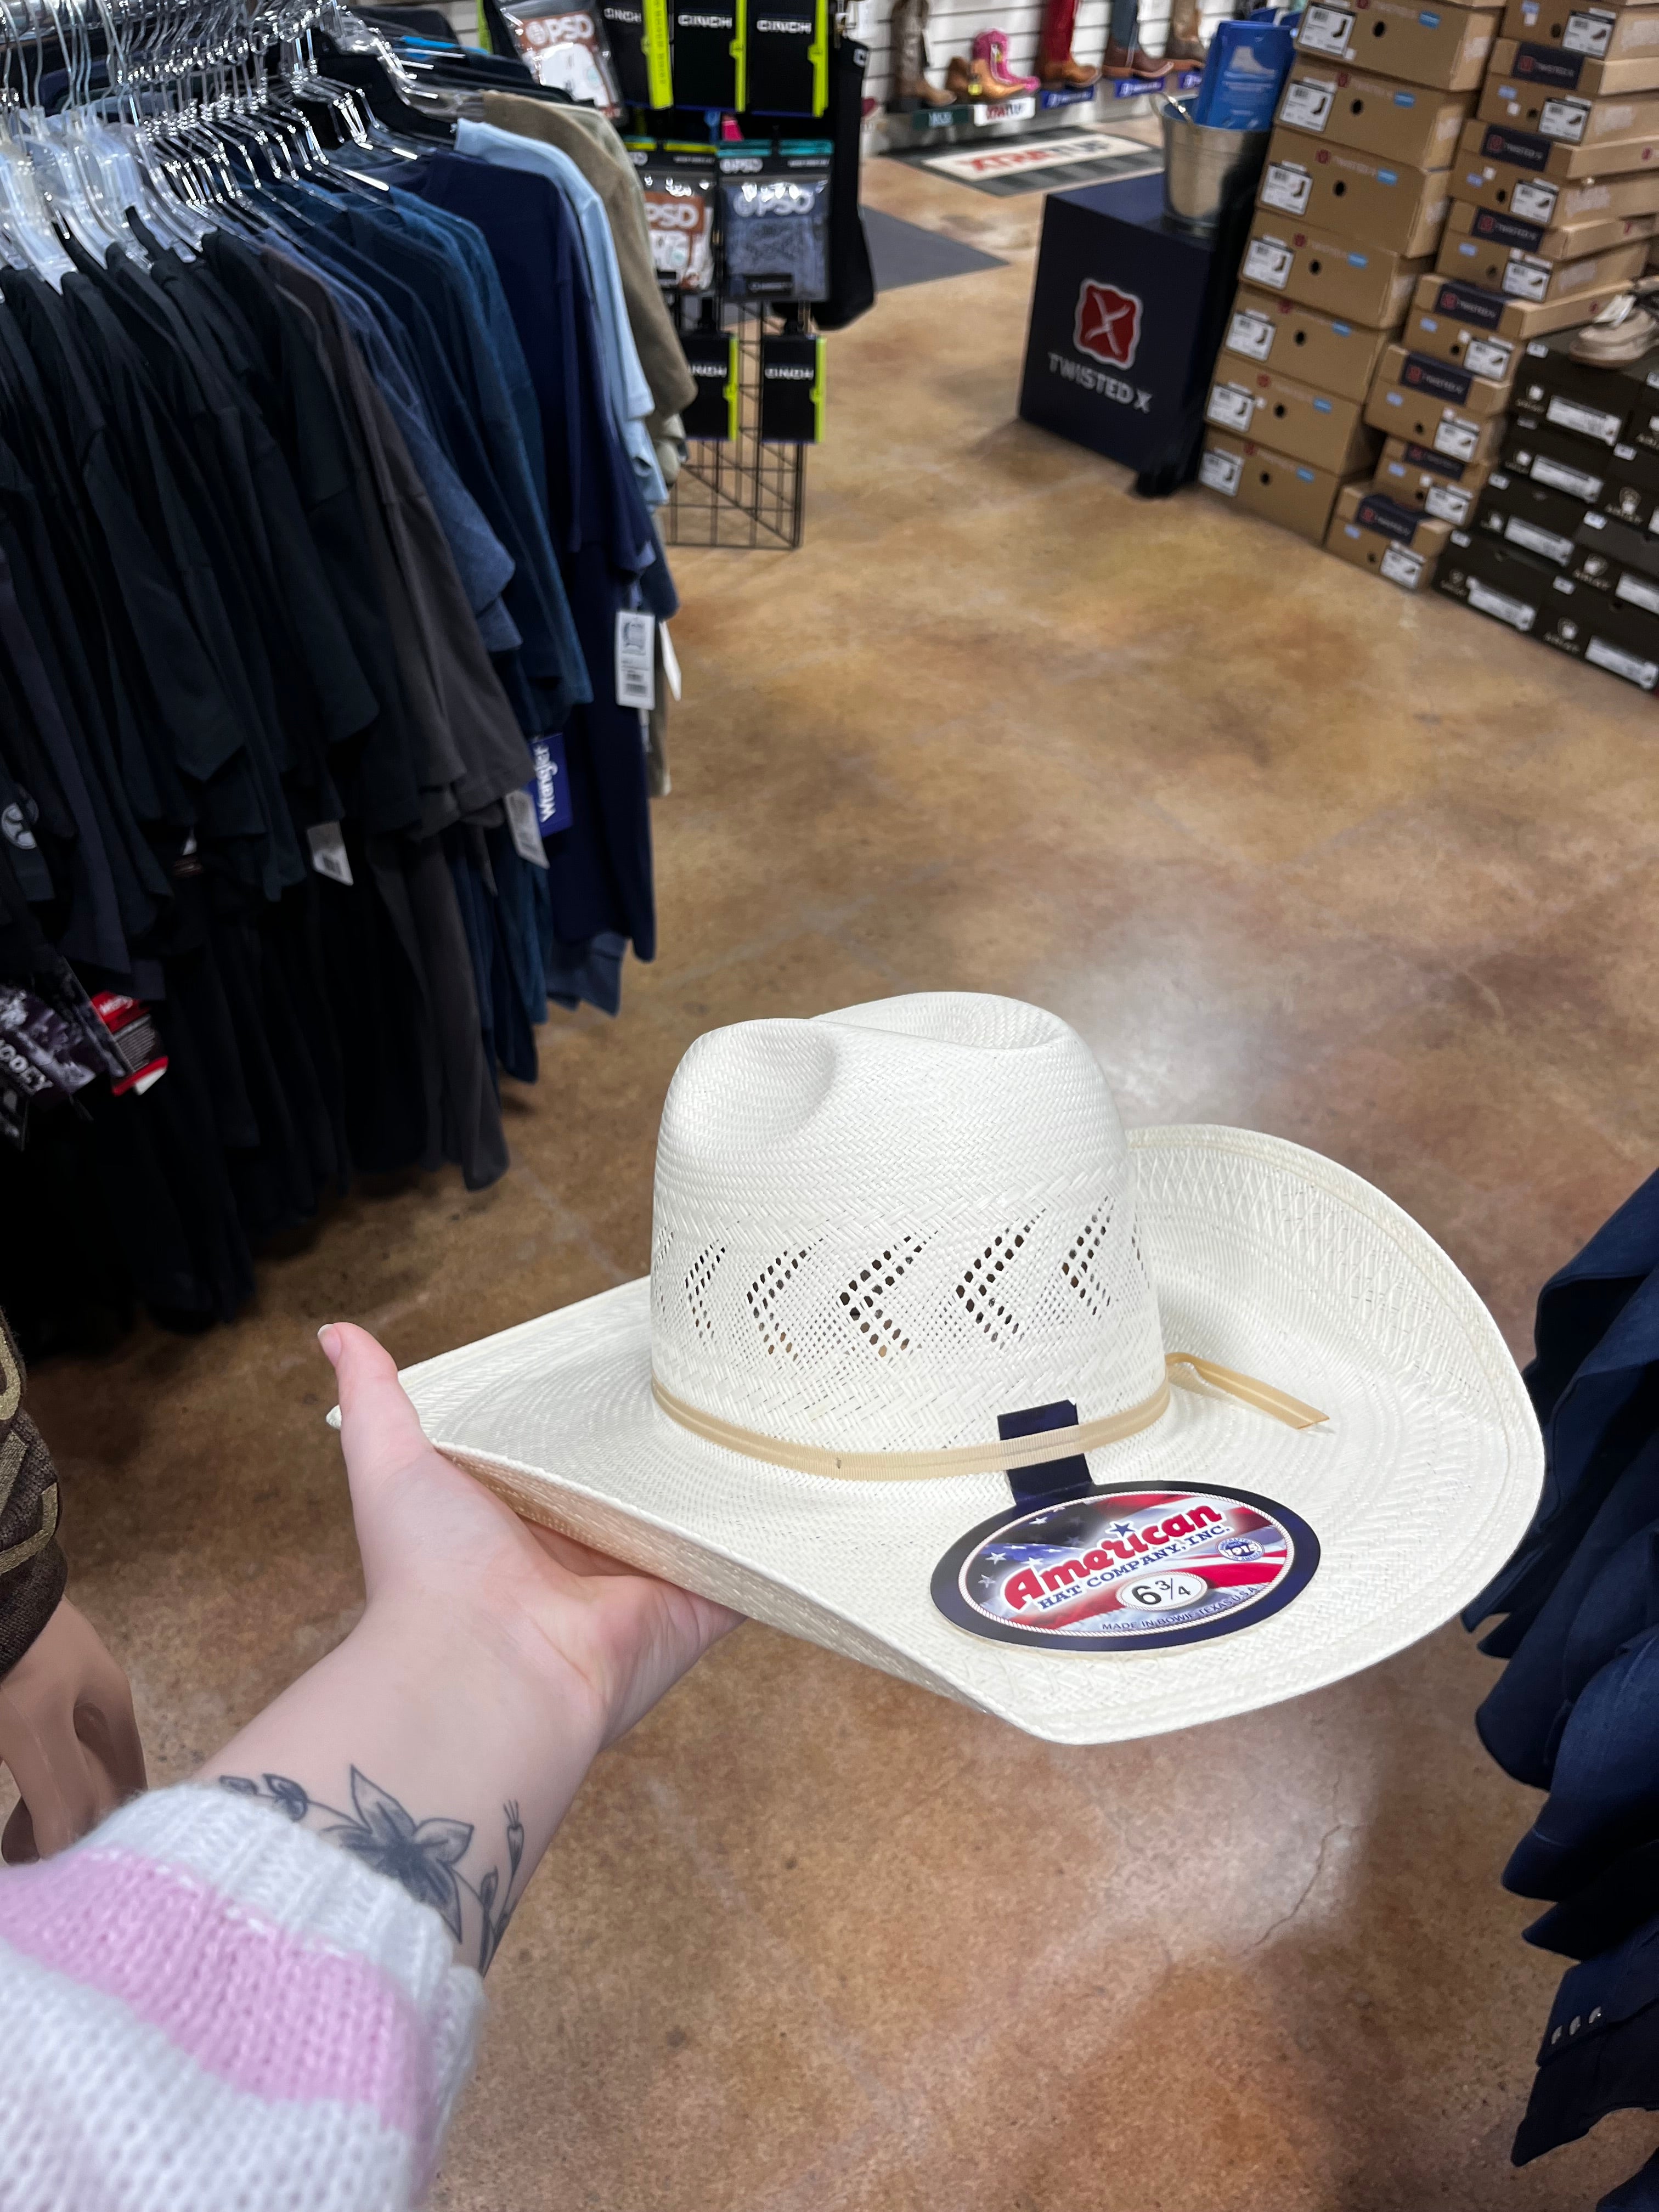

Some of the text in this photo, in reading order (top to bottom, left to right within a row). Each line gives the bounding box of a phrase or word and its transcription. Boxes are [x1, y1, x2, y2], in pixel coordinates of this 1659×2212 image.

[604, 8, 641, 23] CINCH
[678, 14, 732, 28] CINCH
[544, 14, 594, 43] PSD
[757, 19, 812, 34] CINCH
[645, 204, 698, 228] PSD
[765, 368, 814, 380] CINCH
[1048, 353, 1152, 414] TWISTED X
[534, 744, 558, 822] Wrangler
[1005, 1505, 1222, 1610] American
[1224, 1543, 1259, 1557] 1915
[1036, 1525, 1230, 1610] HAT COMPANY, INC.
[1102, 1622, 1137, 1631] MADE
[1142, 1620, 1154, 1629] IN
